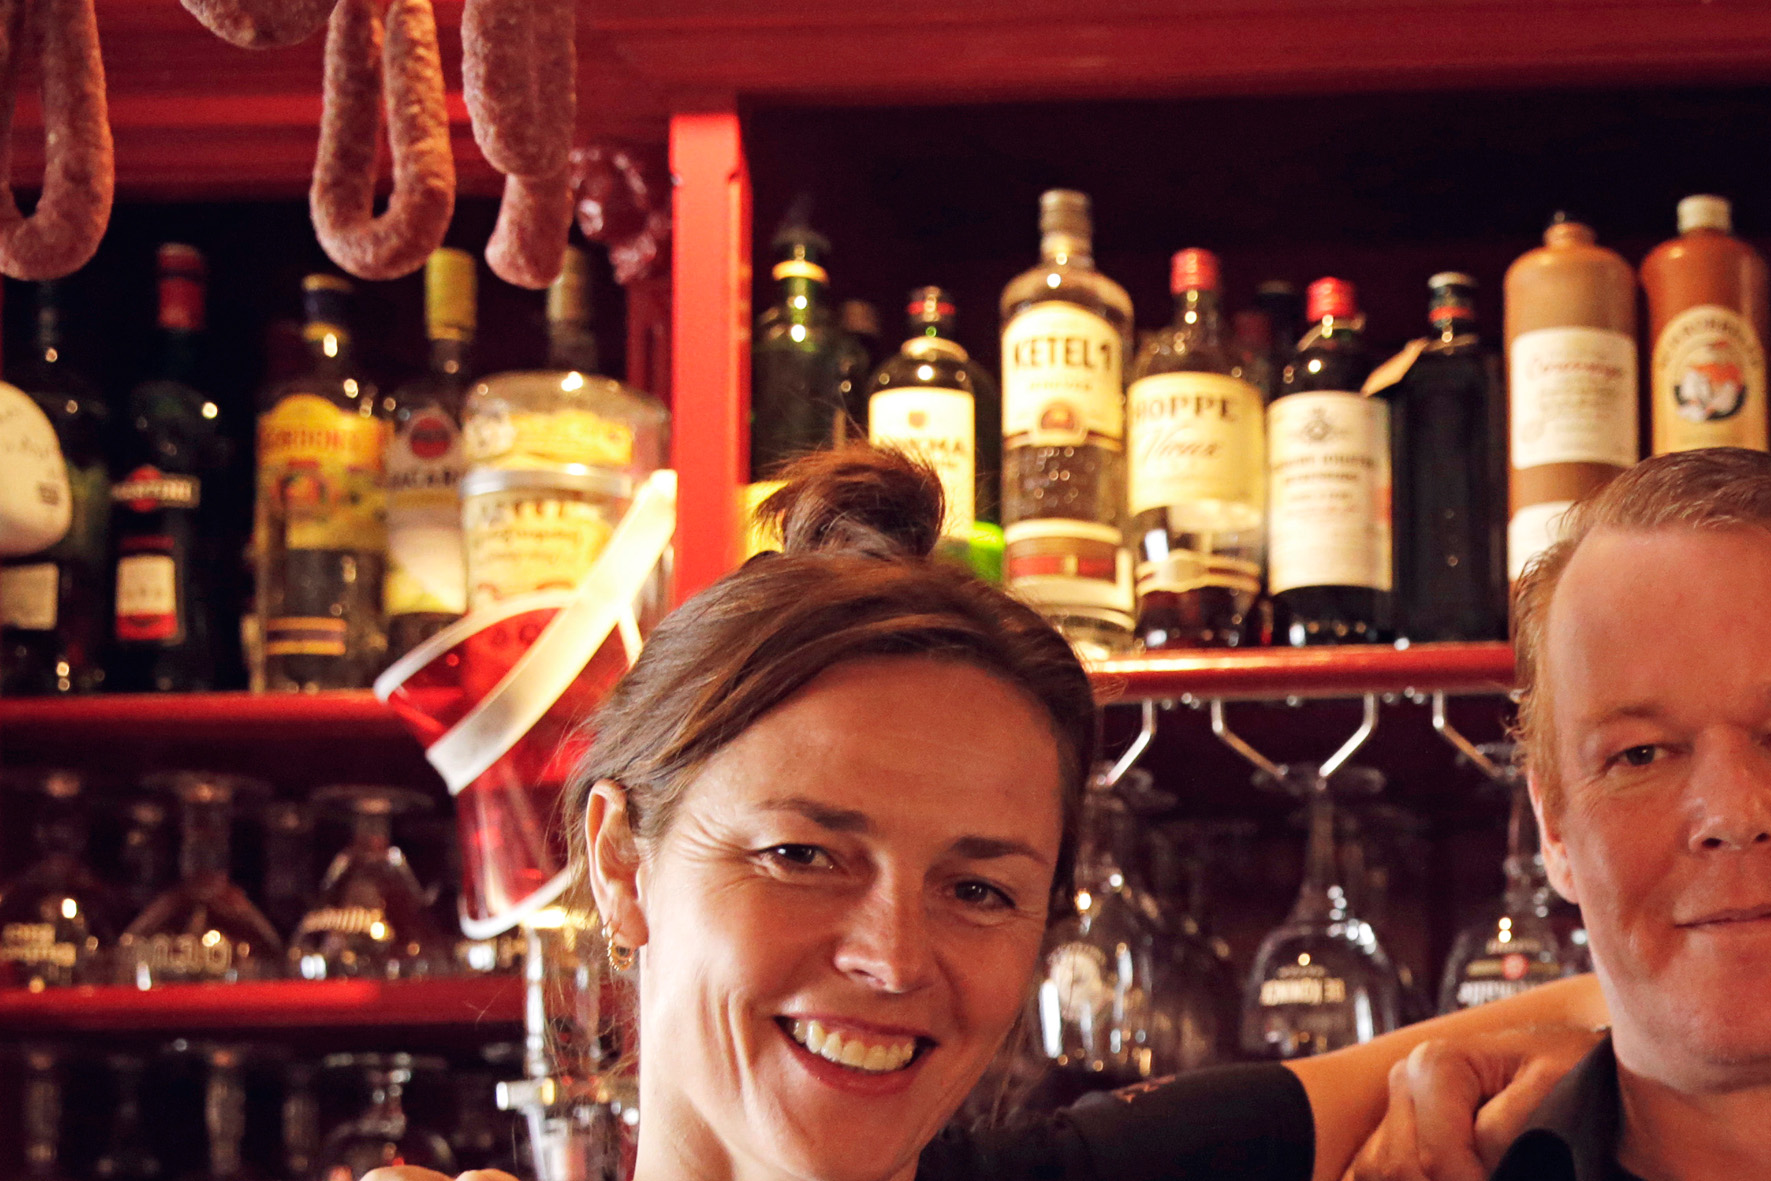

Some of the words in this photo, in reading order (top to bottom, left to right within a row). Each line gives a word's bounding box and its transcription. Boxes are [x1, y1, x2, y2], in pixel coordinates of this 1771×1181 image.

[1012, 336, 1096, 369] KETEL
[1099, 342, 1113, 371] 1
[1133, 394, 1238, 422] HOPPE
